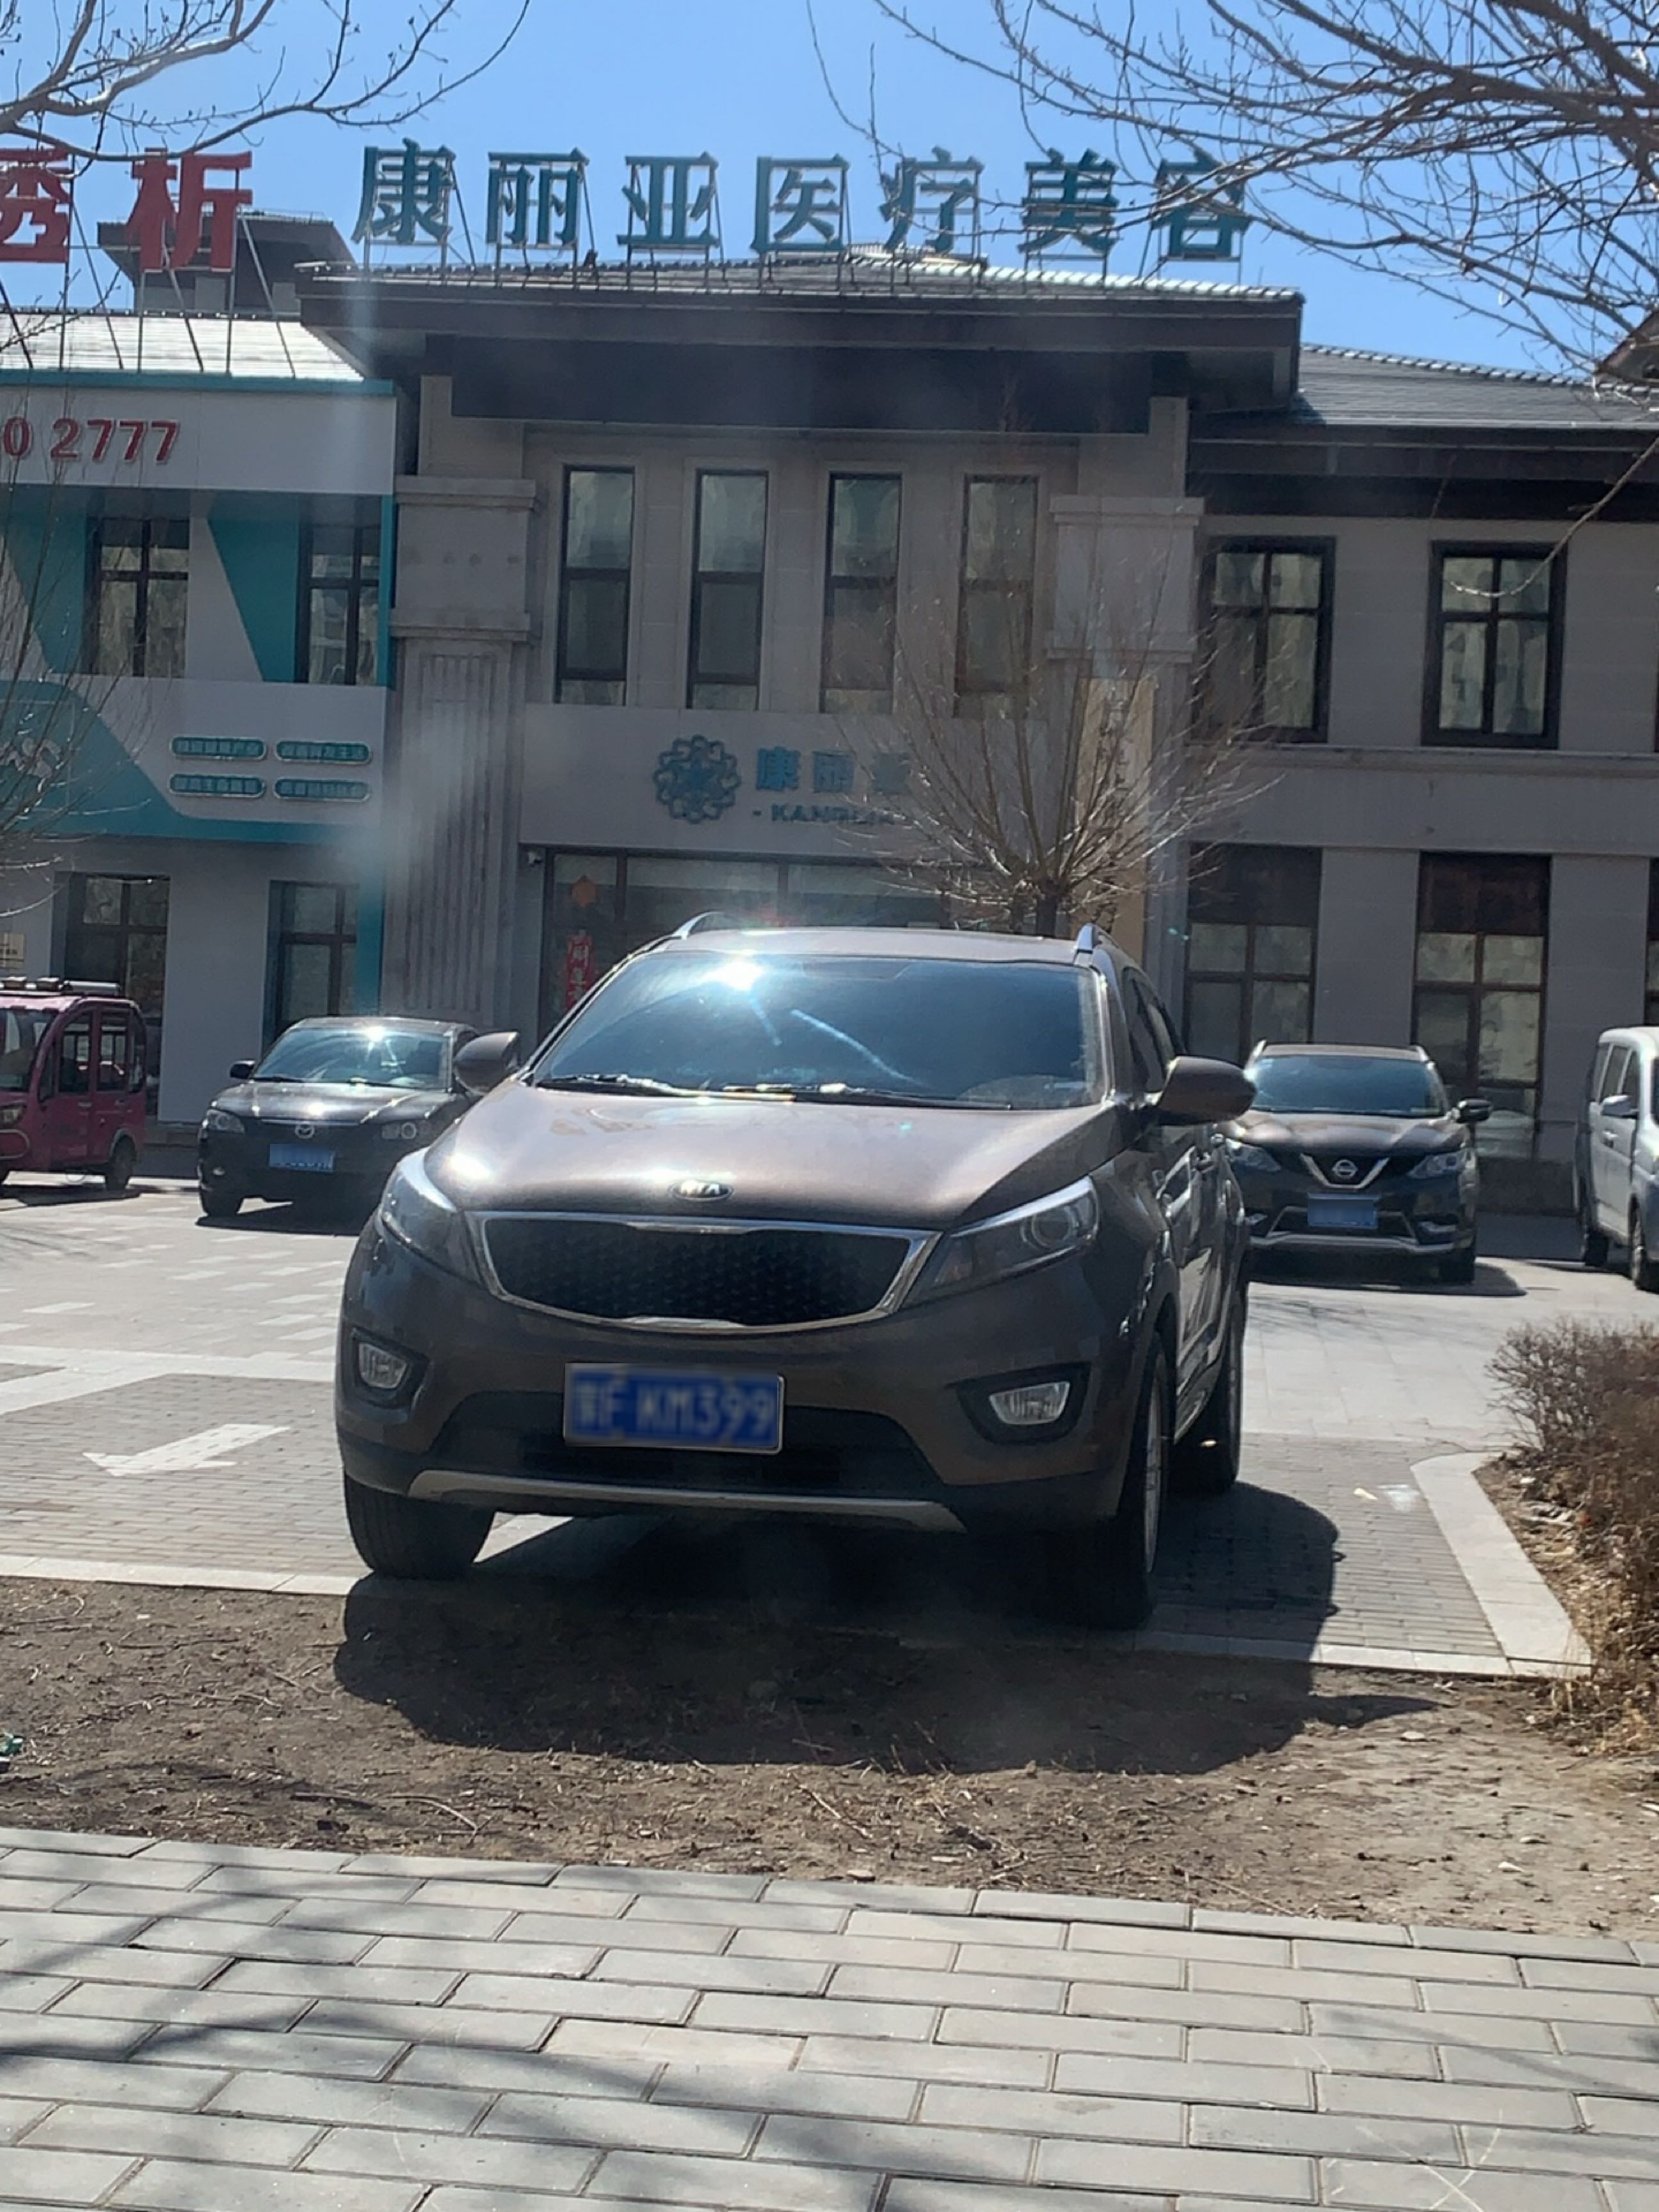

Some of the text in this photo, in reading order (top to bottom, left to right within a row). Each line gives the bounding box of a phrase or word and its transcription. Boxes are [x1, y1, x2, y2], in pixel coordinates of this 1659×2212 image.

[351, 138, 1250, 259] 康丽亚医疗美容
